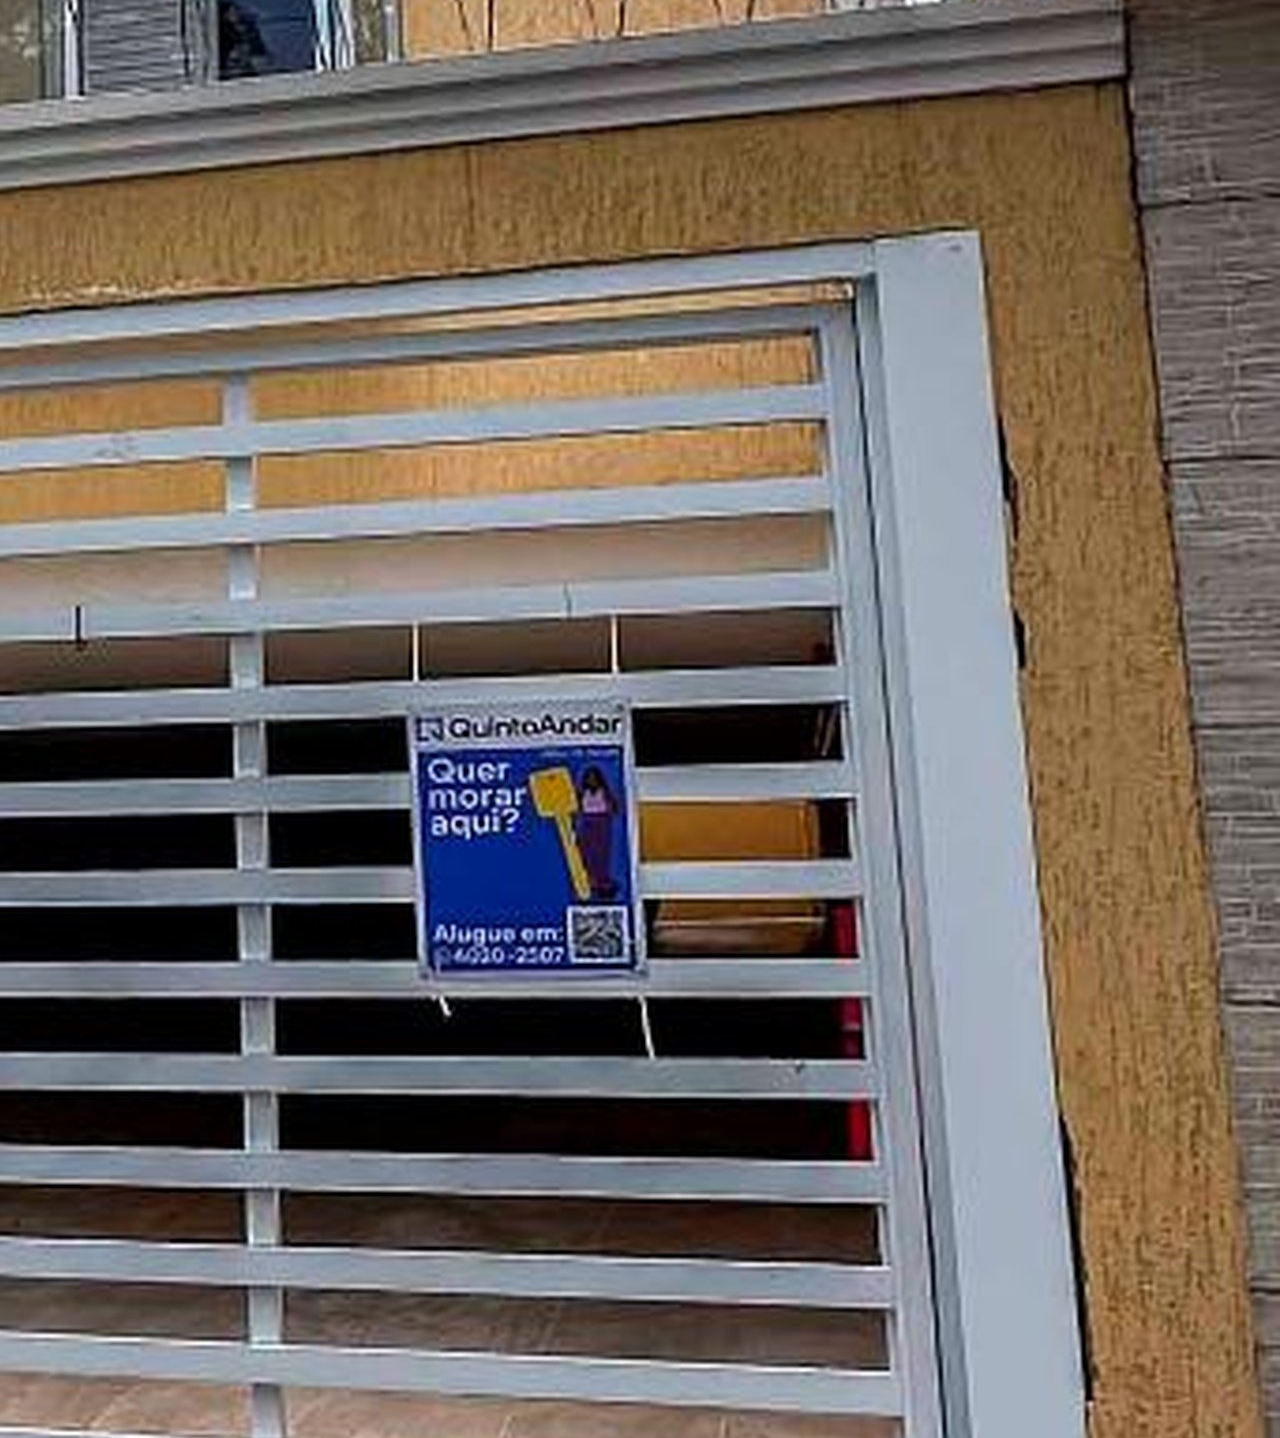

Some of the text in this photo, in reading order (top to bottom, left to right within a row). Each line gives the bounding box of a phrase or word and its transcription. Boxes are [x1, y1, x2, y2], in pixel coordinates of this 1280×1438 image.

[449, 714, 621, 738] QuintoAndar
[427, 758, 510, 784] Quer
[428, 787, 527, 809] morar
[431, 808, 520, 840] aqui?
[433, 924, 564, 947] Alugue em:
